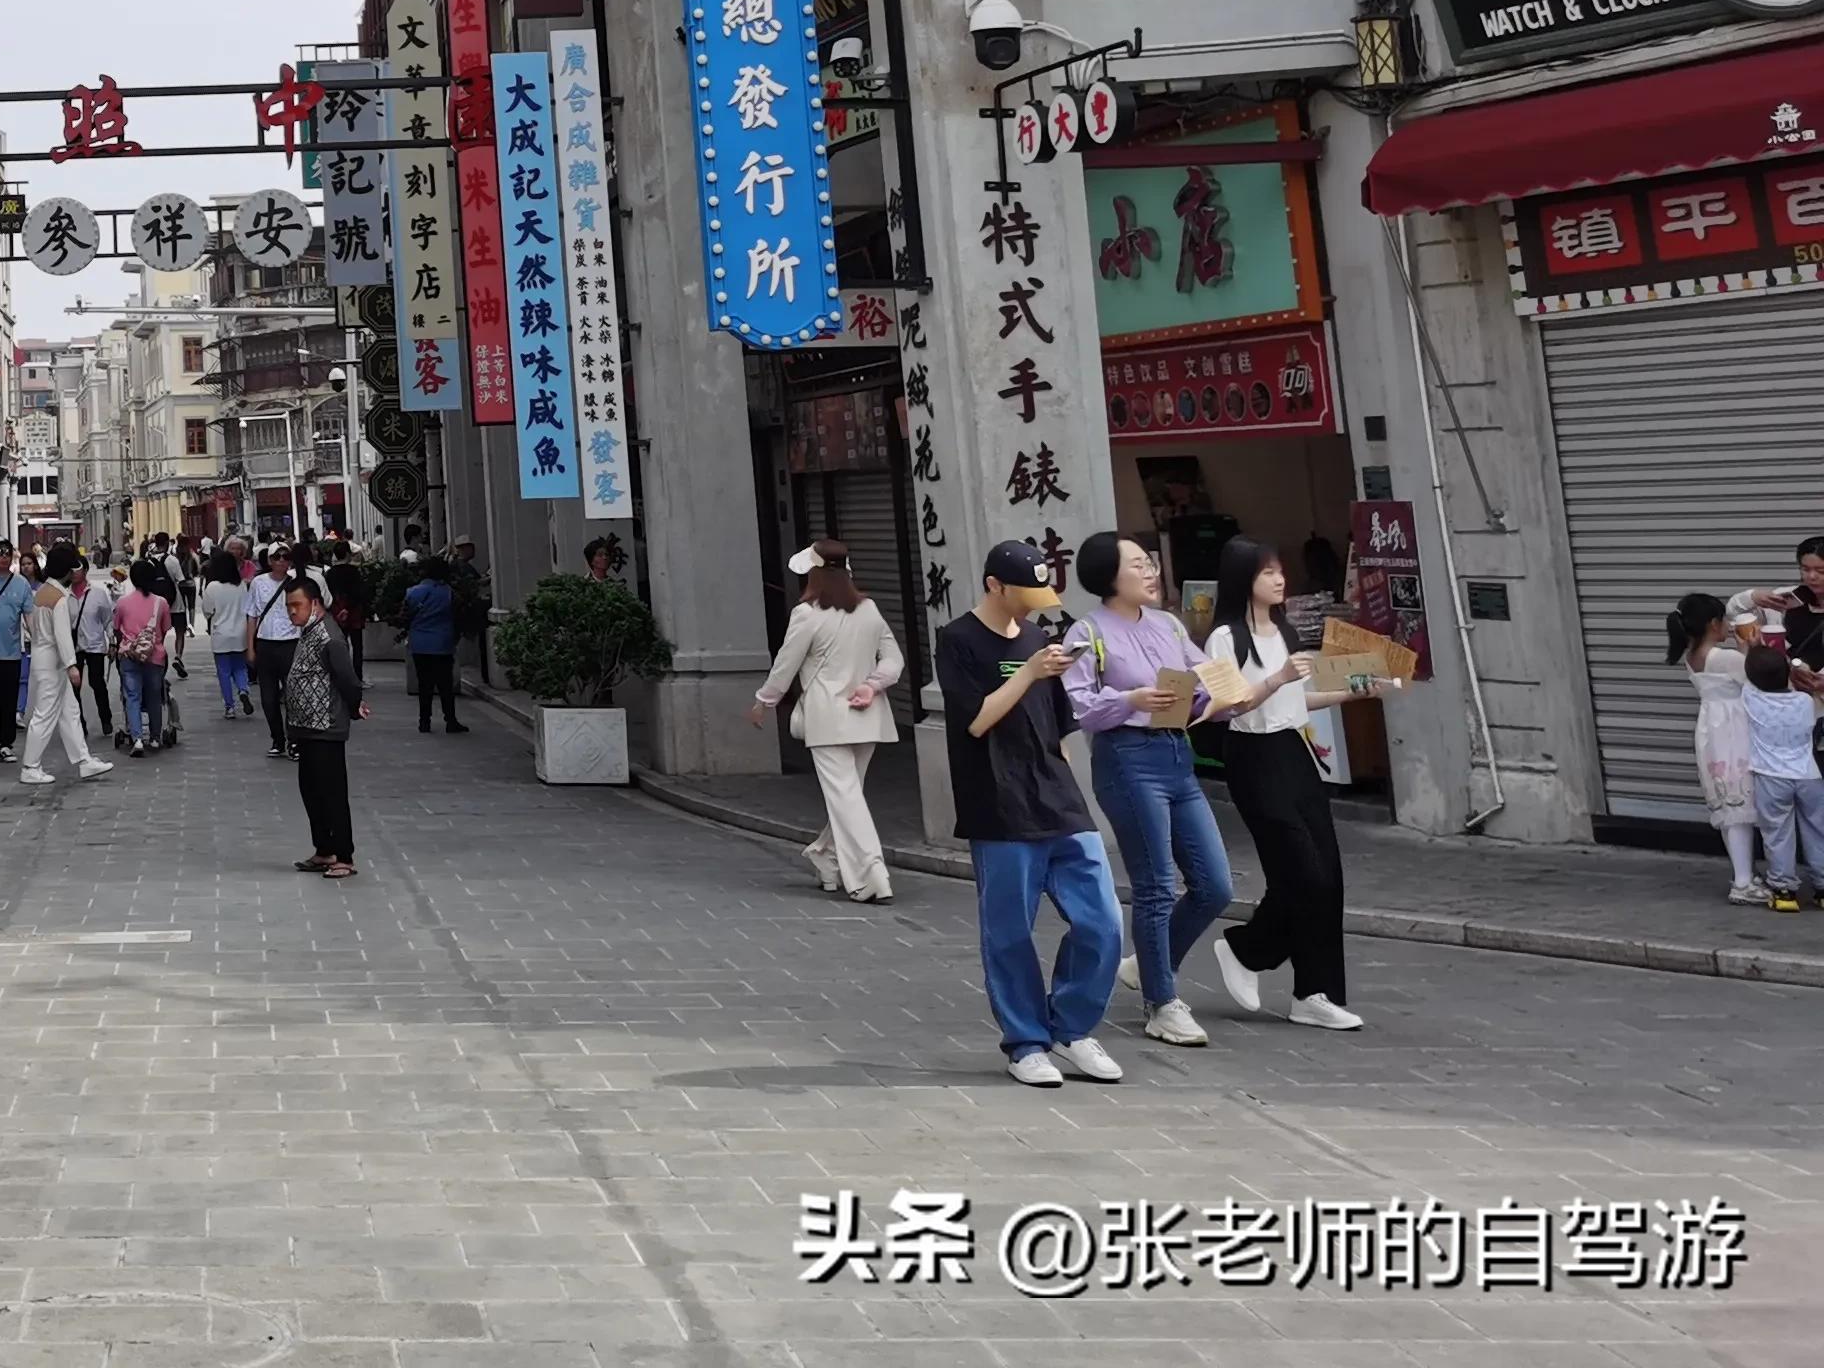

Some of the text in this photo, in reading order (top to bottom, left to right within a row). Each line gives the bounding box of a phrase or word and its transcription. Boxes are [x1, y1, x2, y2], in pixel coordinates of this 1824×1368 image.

[1479, 0, 1555, 40] WATCH
[505, 73, 567, 478] 大成記天然辣味咸魚
